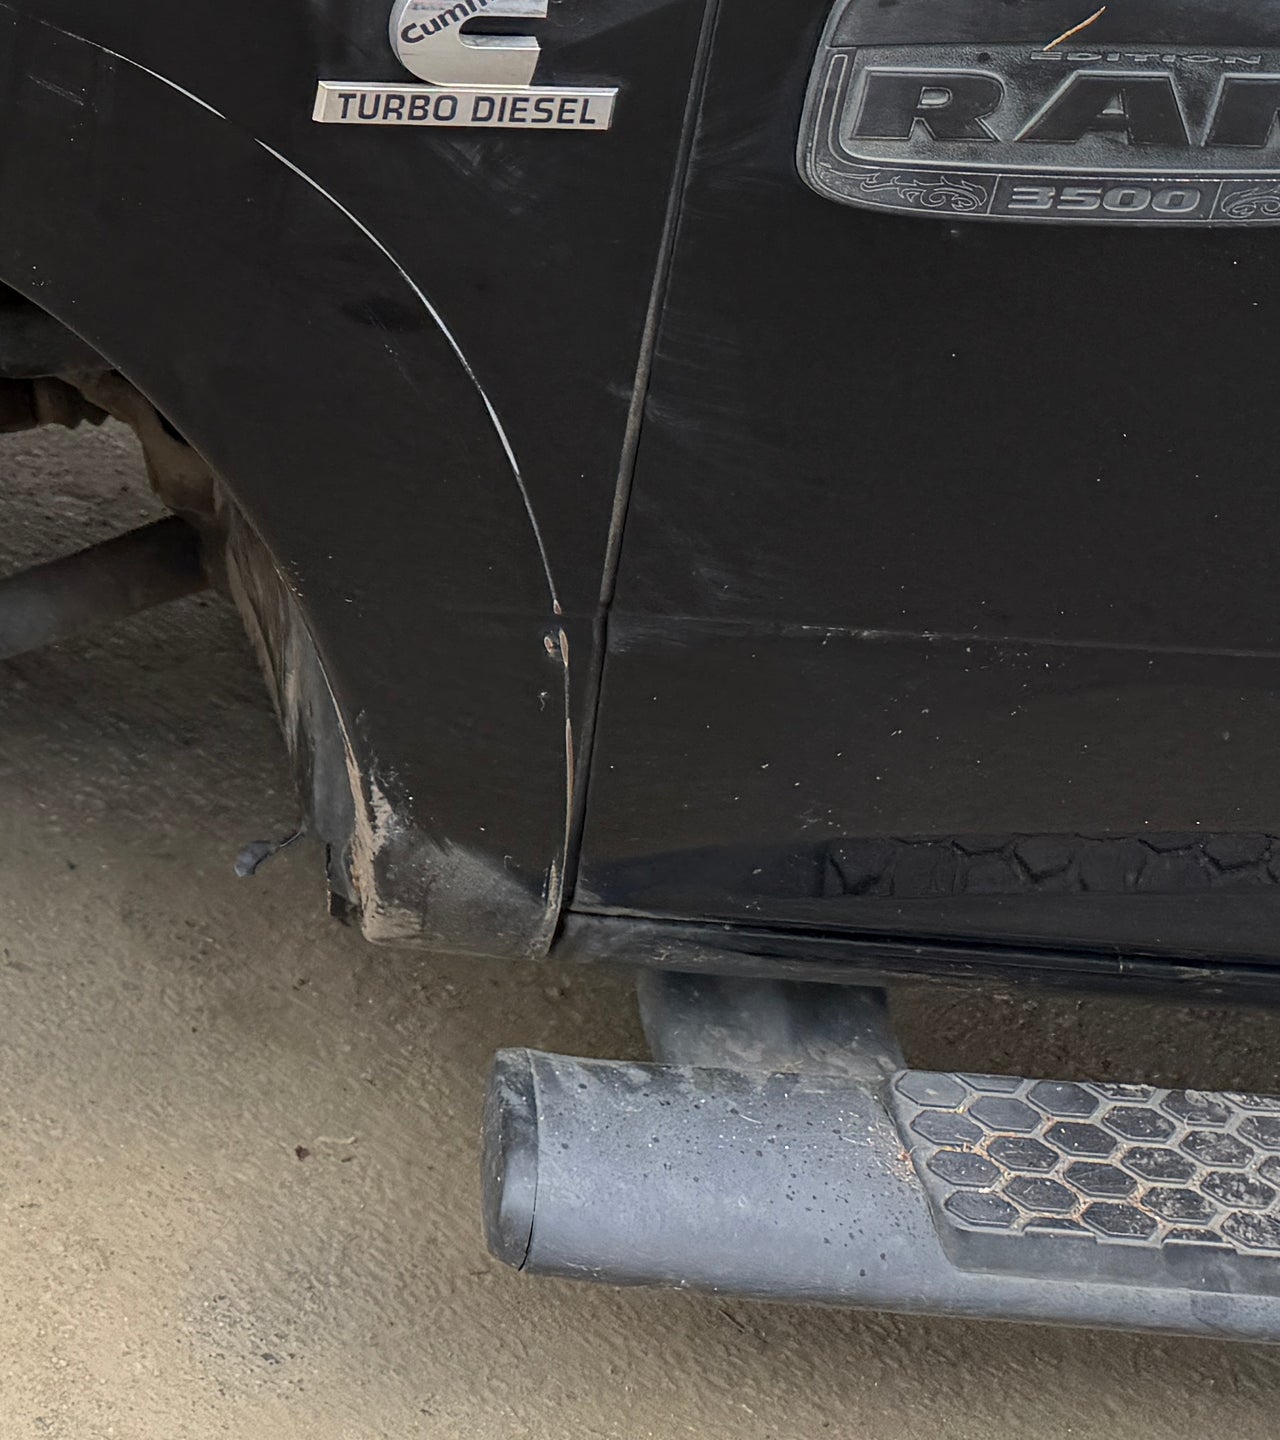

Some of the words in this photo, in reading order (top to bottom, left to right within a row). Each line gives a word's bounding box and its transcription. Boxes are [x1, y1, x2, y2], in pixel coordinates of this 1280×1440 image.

[1029, 50, 1262, 65] EDITION
[338, 92, 459, 122] TURBO
[470, 95, 596, 125] DIESEL
[1006, 185, 1202, 213] 3500
